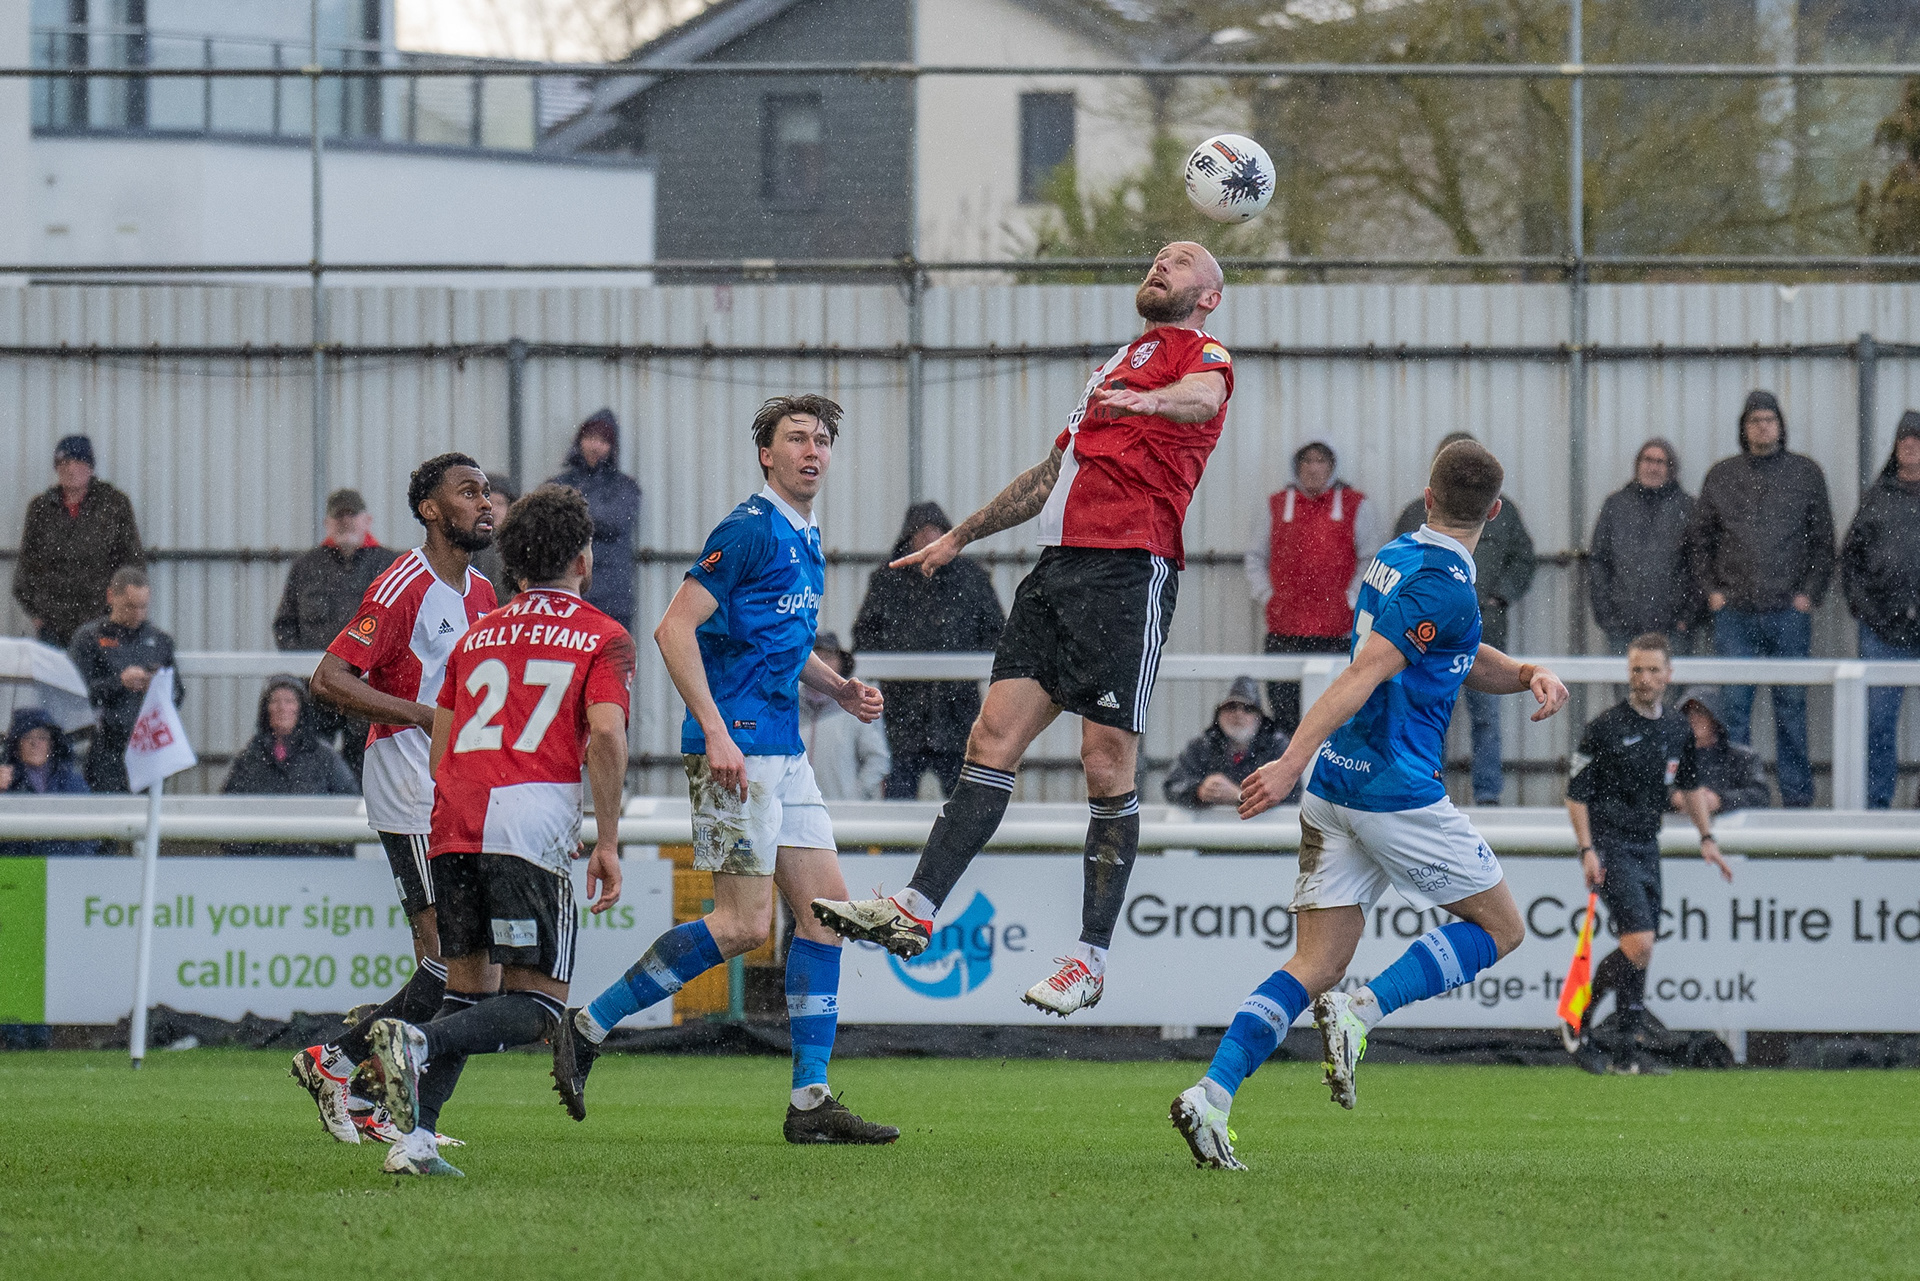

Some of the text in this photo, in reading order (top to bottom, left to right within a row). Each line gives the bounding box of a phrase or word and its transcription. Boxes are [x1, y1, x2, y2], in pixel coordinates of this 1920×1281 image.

[502, 598, 581, 618] MKJ
[463, 623, 601, 653] KELLY-EVANS
[453, 658, 576, 754] 27
[1097, 700, 1120, 709] adidas
[1415, 873, 1452, 893] East
[84, 895, 141, 928] For
[153, 894, 195, 928] all
[207, 904, 292, 936] your
[303, 895, 374, 937] sign
[1126, 894, 1294, 950] Grang
[1527, 896, 1708, 942] Coch
[1731, 897, 1832, 942] Hire
[177, 950, 260, 988] call:
[268, 953, 337, 988] 020
